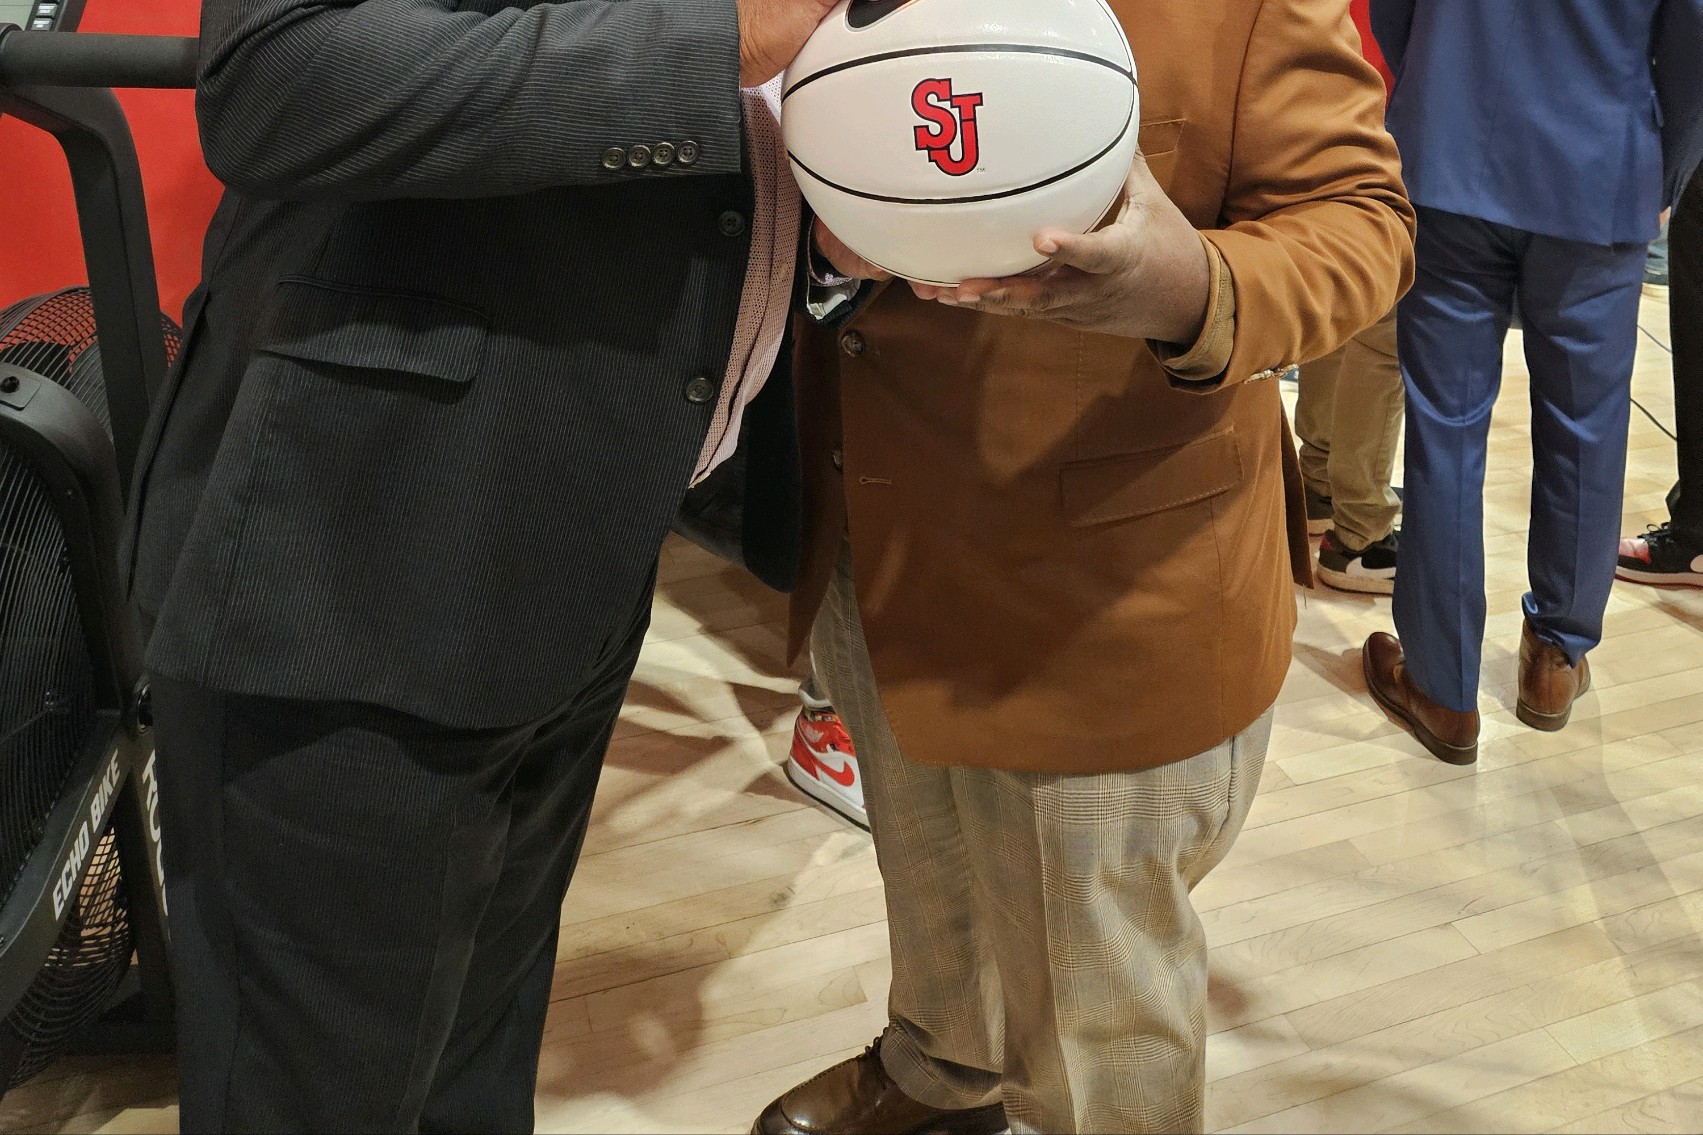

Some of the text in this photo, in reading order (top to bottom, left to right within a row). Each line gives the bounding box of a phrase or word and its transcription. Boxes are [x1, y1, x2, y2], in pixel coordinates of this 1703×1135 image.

[911, 78, 984, 177] SJ
[52, 748, 121, 921] ECHO BIKE
